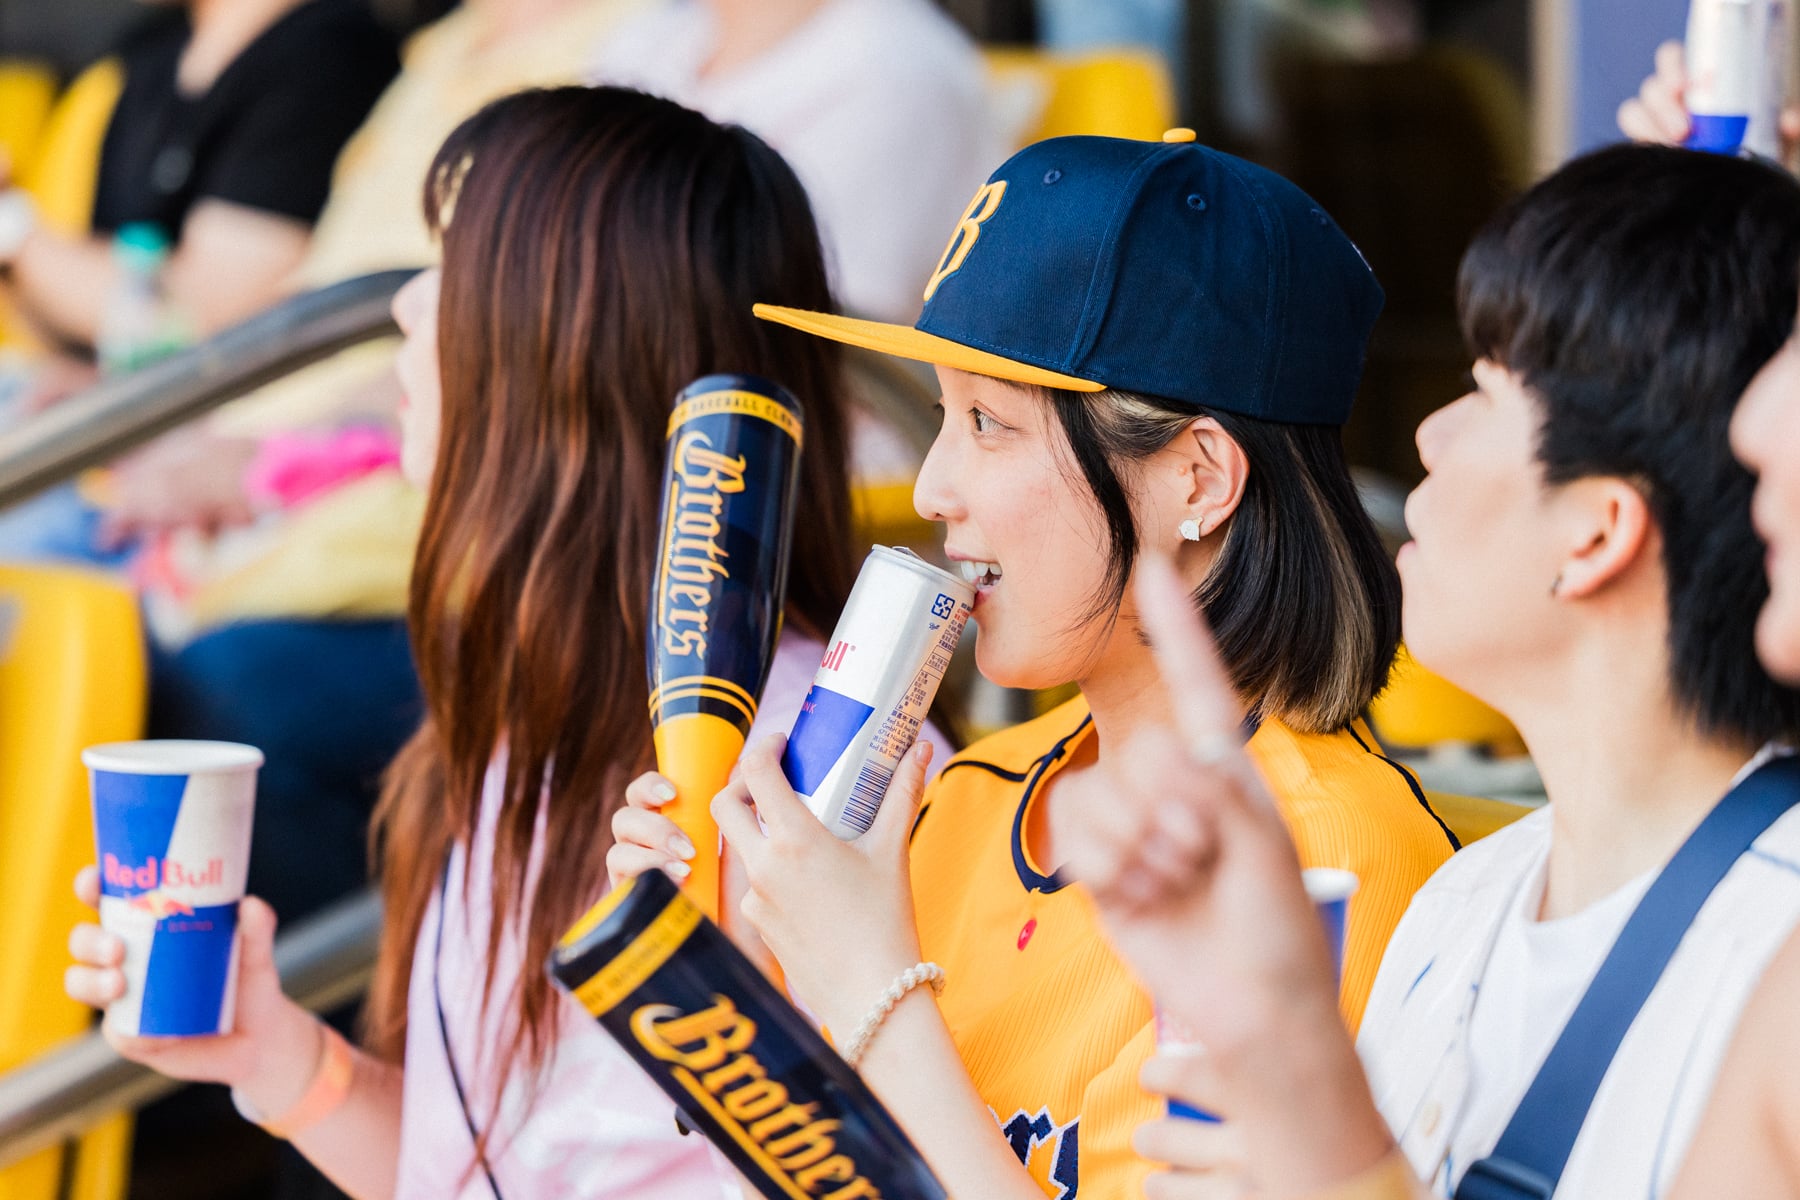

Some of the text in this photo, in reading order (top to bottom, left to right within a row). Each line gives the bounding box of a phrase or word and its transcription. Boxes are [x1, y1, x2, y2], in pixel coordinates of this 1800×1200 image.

[923, 180, 1008, 302] B
[664, 430, 747, 660] Brothers
[821, 640, 849, 672] ull
[104, 852, 224, 890] Red Bull
